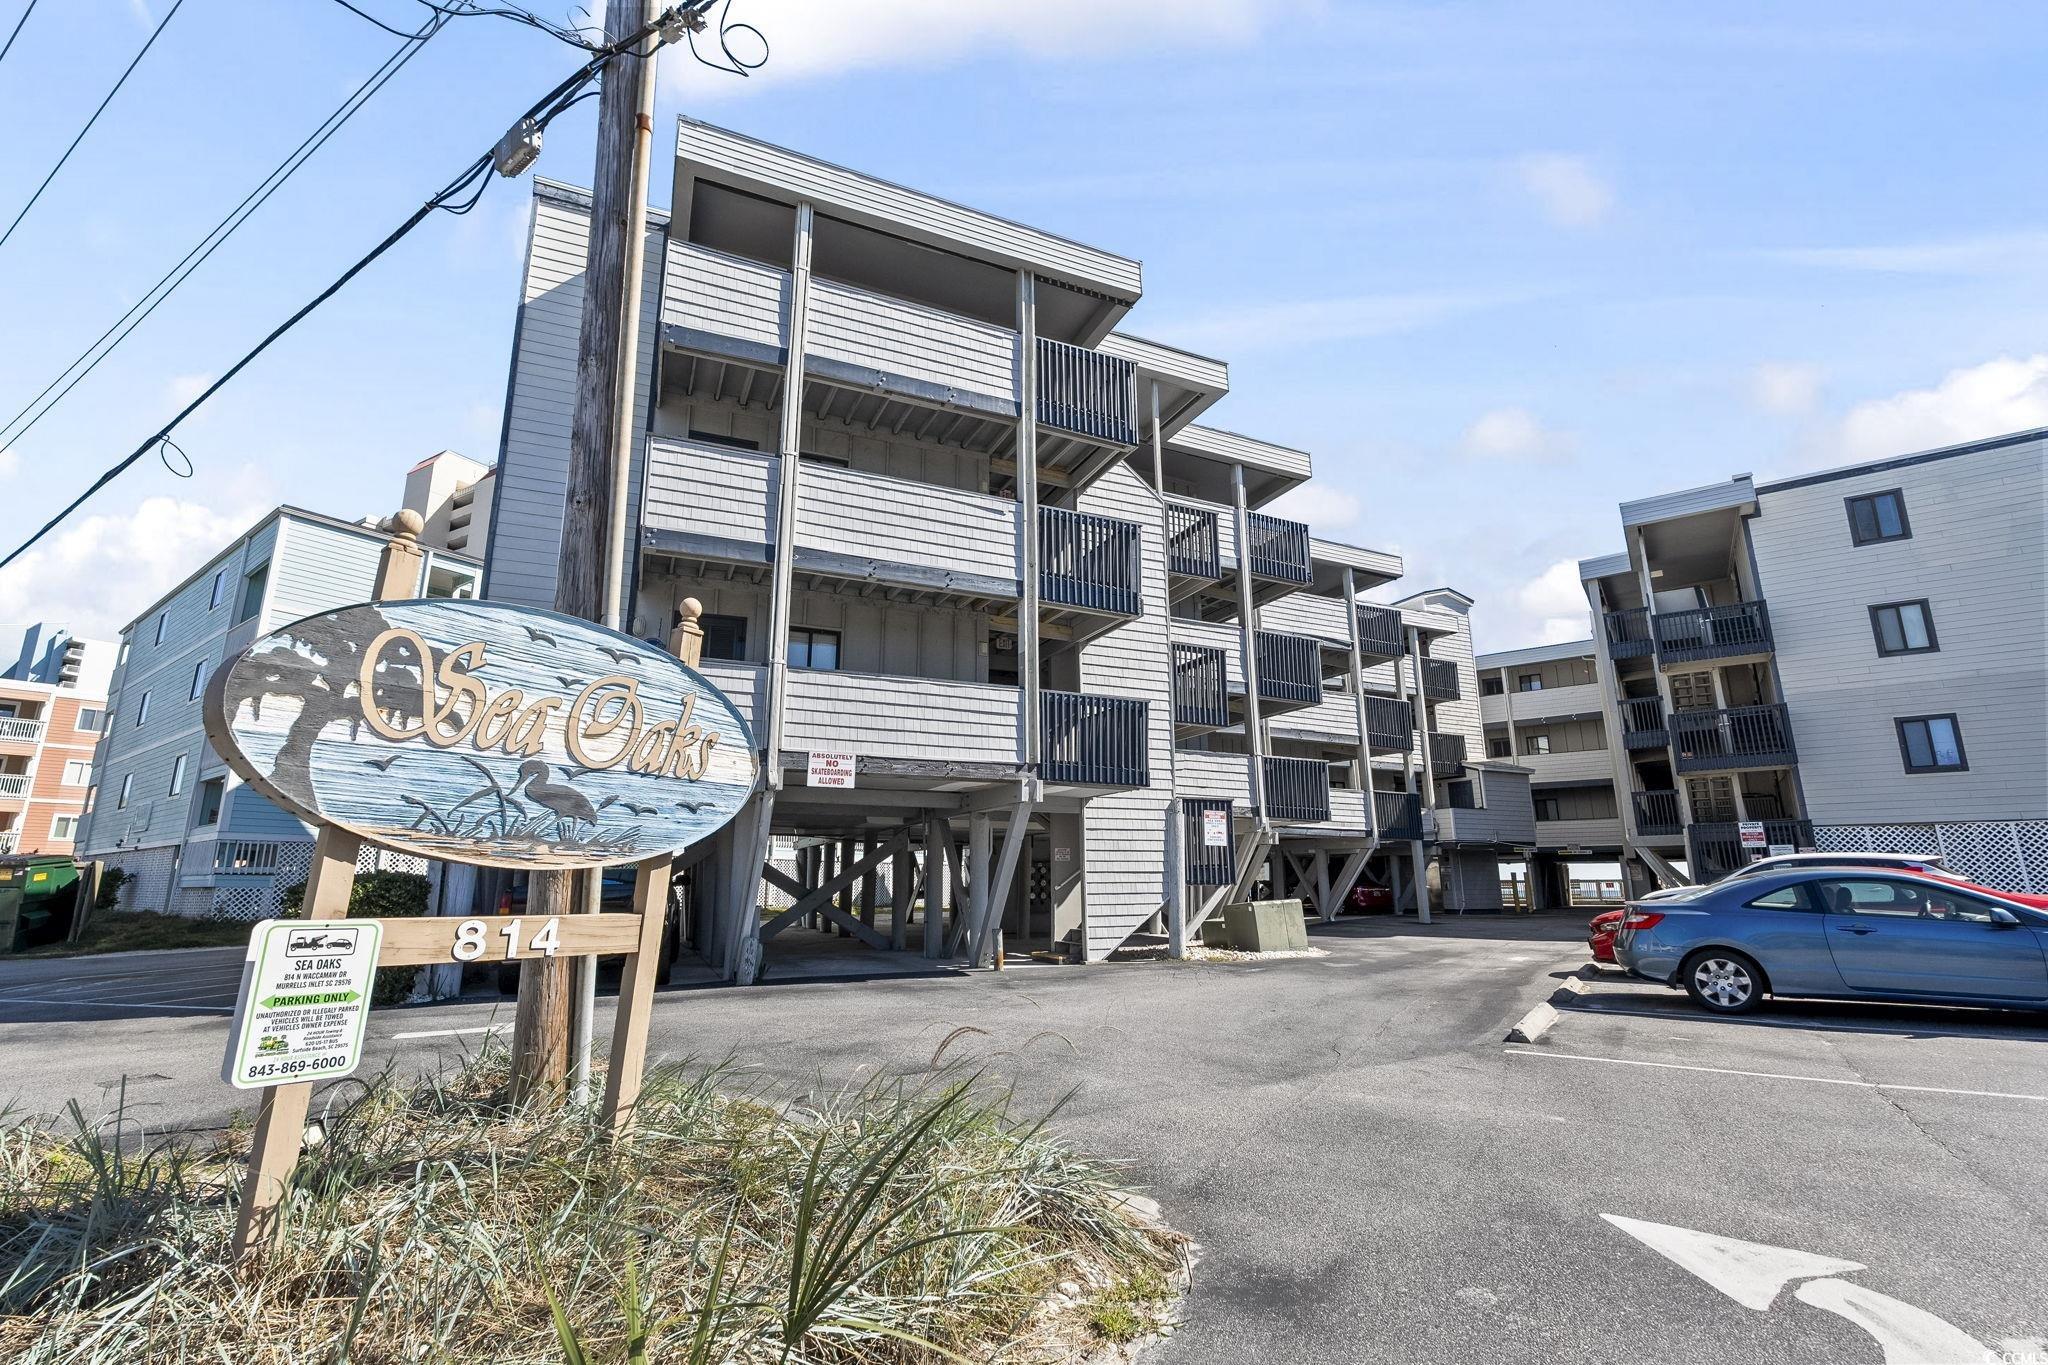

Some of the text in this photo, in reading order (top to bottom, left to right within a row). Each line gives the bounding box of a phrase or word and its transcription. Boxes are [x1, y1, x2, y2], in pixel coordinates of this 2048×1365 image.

[360, 628, 720, 781] Sea Oaks
[826, 760, 839, 768] NO
[811, 768, 852, 776] SKATEBOARDING
[818, 776, 844, 786] ALLOWED
[451, 918, 560, 962] 814
[294, 958, 342, 970] SEA OAKS
[273, 992, 350, 1006] PARKING ONLY
[256, 1010, 301, 1019] UNAUTHORIZED
[272, 1016, 299, 1025] VEHICLES
[272, 1024, 300, 1032] VEHICLES
[323, 1019, 348, 1027] EXPENSE
[248, 1056, 346, 1078] 843-869-6000
